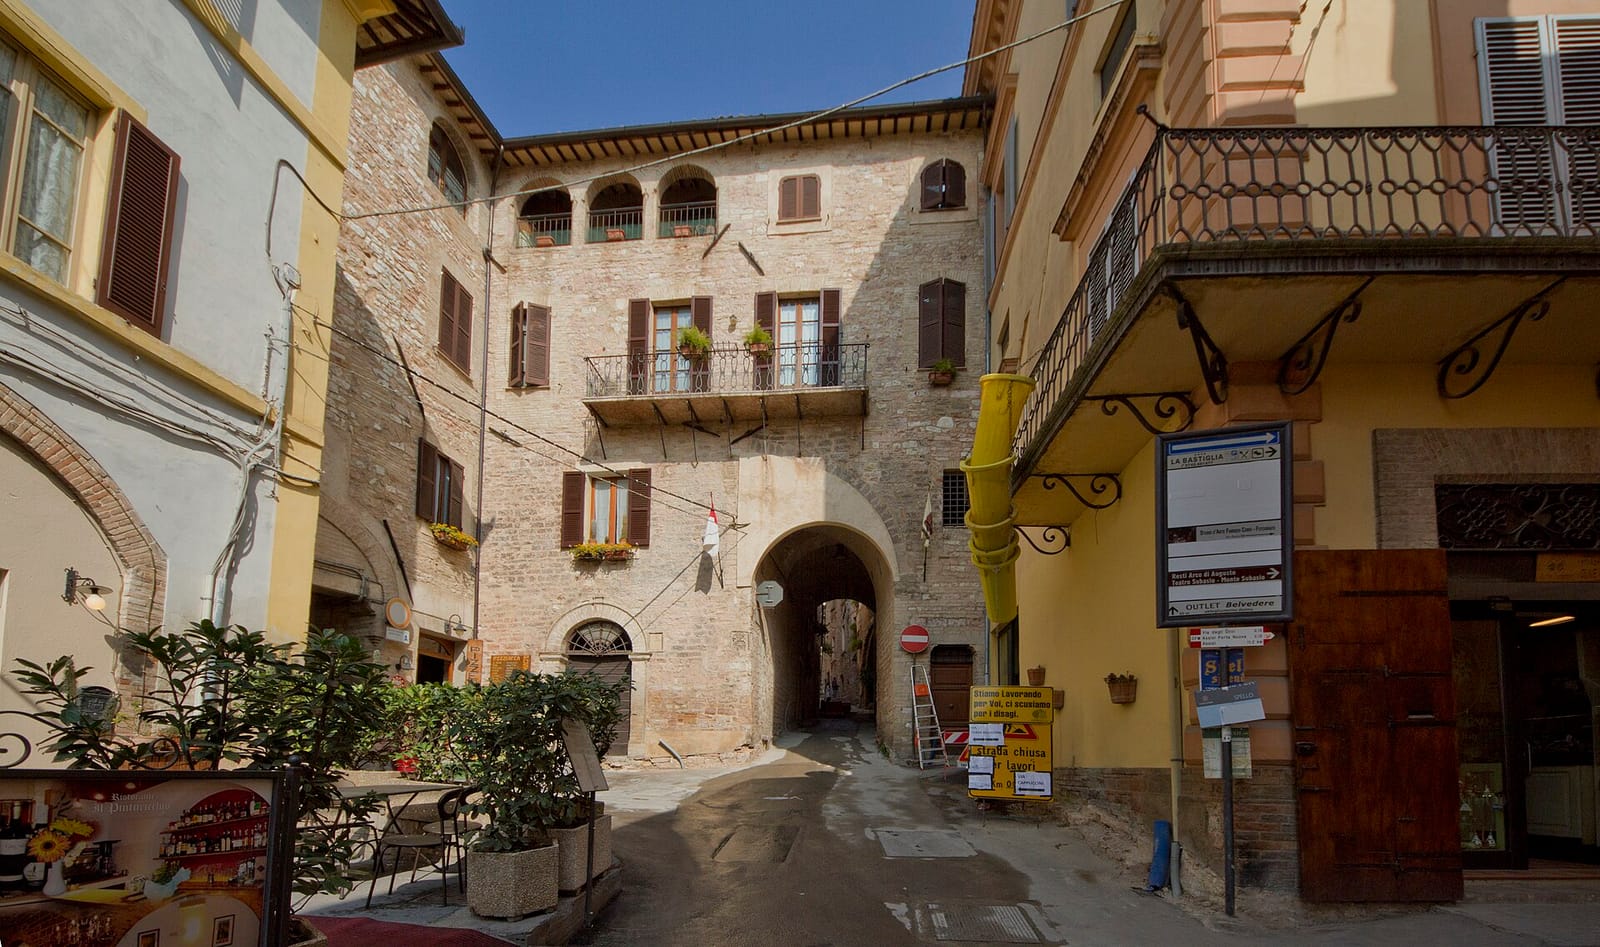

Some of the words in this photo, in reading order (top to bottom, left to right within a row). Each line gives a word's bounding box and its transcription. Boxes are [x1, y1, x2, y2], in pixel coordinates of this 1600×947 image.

[1182, 453, 1224, 464] BASTIGLIA
[1211, 570, 1236, 578] Augusto
[1185, 602, 1220, 611] OUTLET
[1225, 600, 1275, 608] Belvedere
[974, 690, 999, 698] Stiamo
[1001, 690, 1042, 698] Lavorando
[1233, 692, 1254, 700] SPELLO
[974, 701, 987, 709] per
[989, 700, 1003, 709] Voi,
[1014, 701, 1051, 709] scusiamo
[994, 710, 1019, 719] disagi.
[977, 746, 1008, 756] strada
[1013, 747, 1046, 758] chiusa
[1007, 760, 1036, 771] lavori
[111, 793, 156, 801] Ristorante
